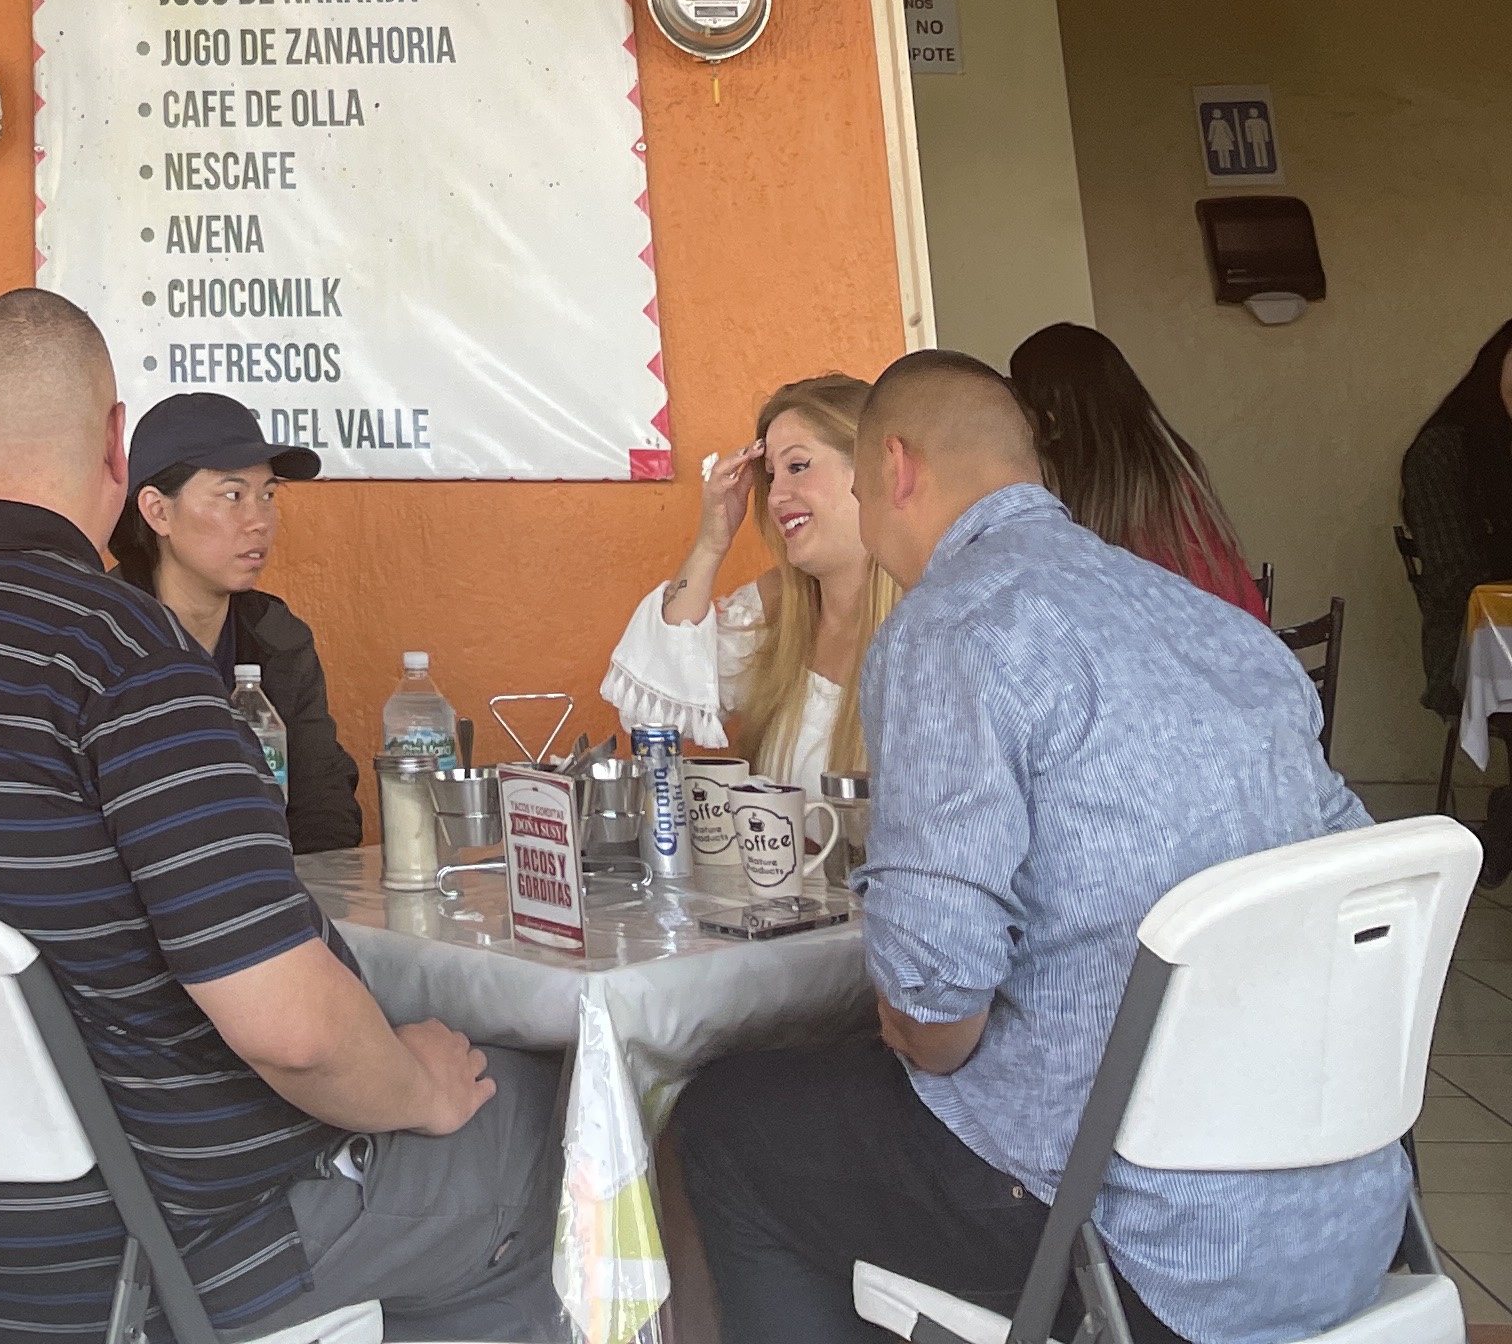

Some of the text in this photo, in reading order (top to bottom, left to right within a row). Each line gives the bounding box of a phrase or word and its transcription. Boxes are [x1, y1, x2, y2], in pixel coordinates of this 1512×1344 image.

[161, 26, 456, 67] JUGO DE ZANAHORIA
[916, 20, 943, 34] NO
[909, 47, 955, 61] POTE
[162, 89, 364, 128] CAFE DE OLLA
[164, 152, 296, 191] NESCAFE
[166, 215, 264, 254] AVENA
[167, 278, 342, 319] CHOCOMILK
[168, 343, 341, 383] REFRESCOS
[271, 408, 431, 449] DEL VALLE
[653, 765, 680, 856] Corona
[689, 801, 731, 821] offee
[514, 844, 566, 879] TACOS Y
[517, 872, 572, 909] GORDITAS
